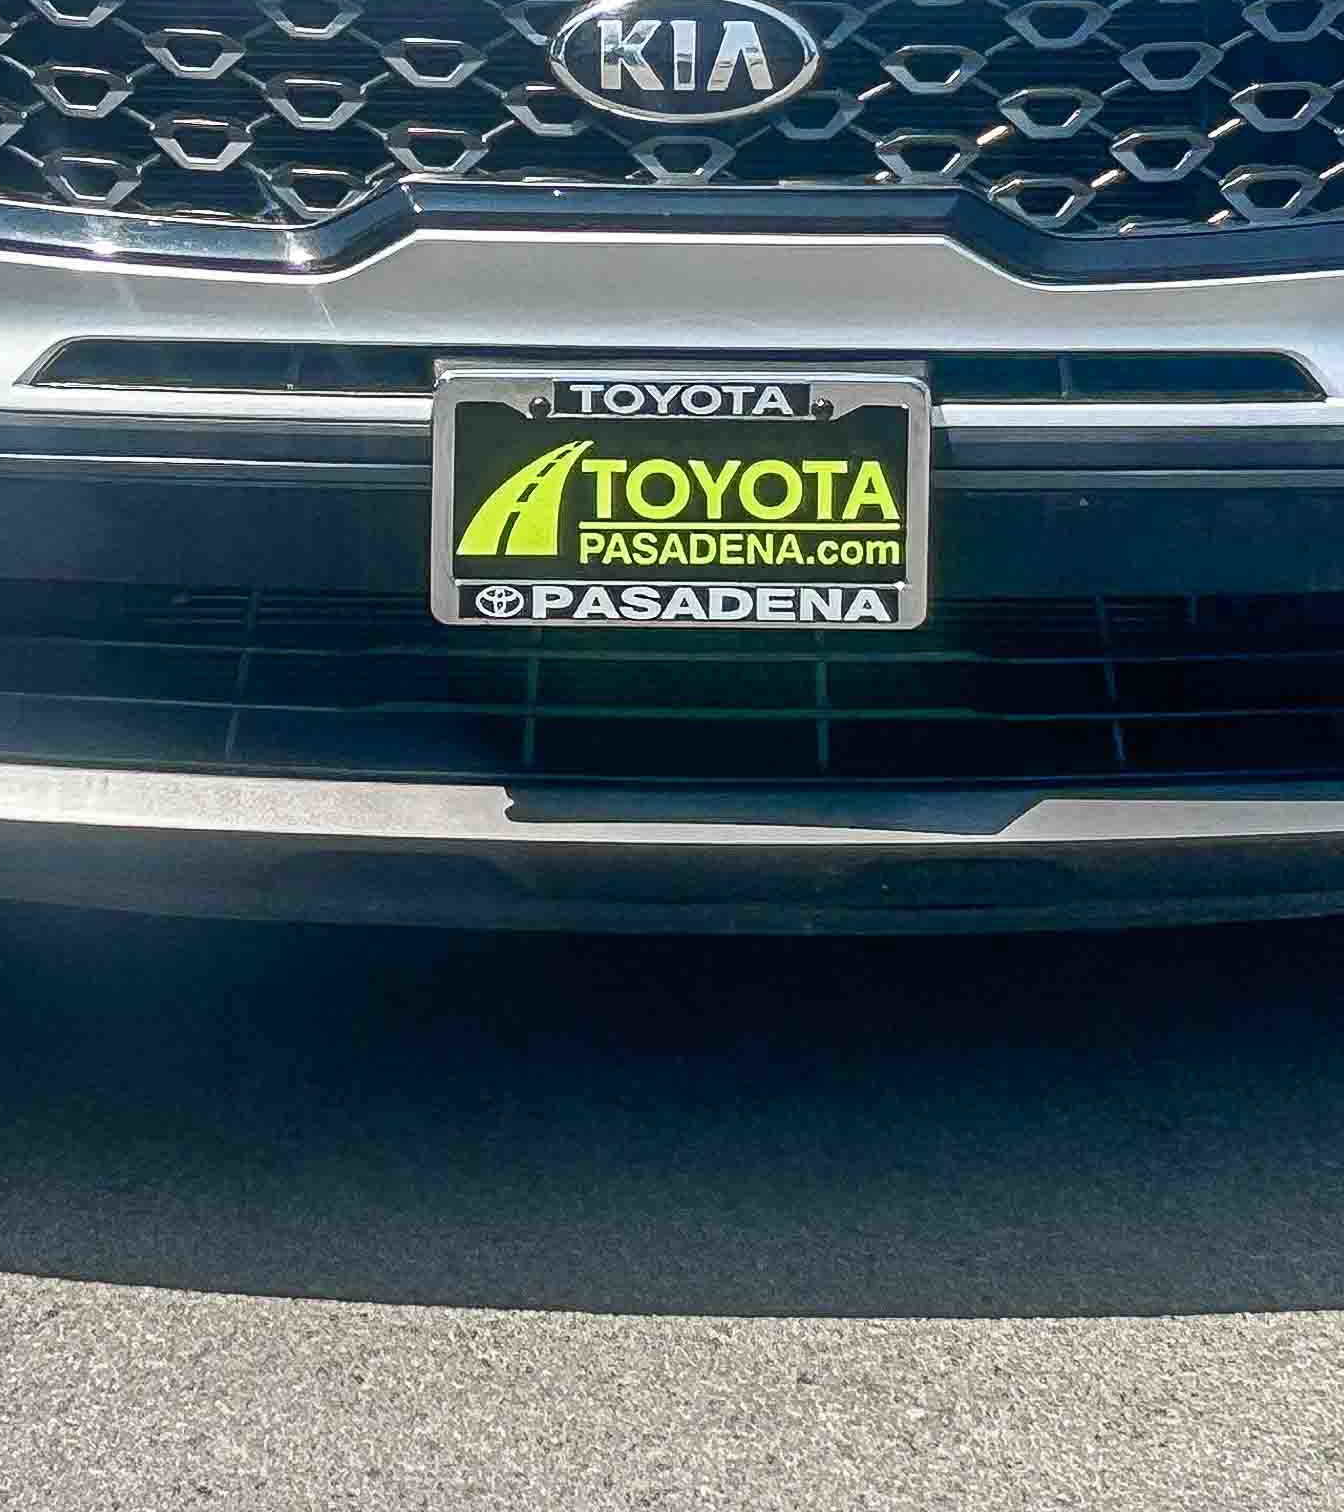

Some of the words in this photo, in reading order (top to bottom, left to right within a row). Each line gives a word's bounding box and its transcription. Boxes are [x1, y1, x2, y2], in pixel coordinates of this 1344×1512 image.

[596, 19, 774, 91] KIA
[569, 384, 794, 417] TOYOTA
[580, 458, 901, 522] TOYOTA
[578, 532, 901, 566] PASADENA.com
[531, 585, 893, 623] PASADENA
